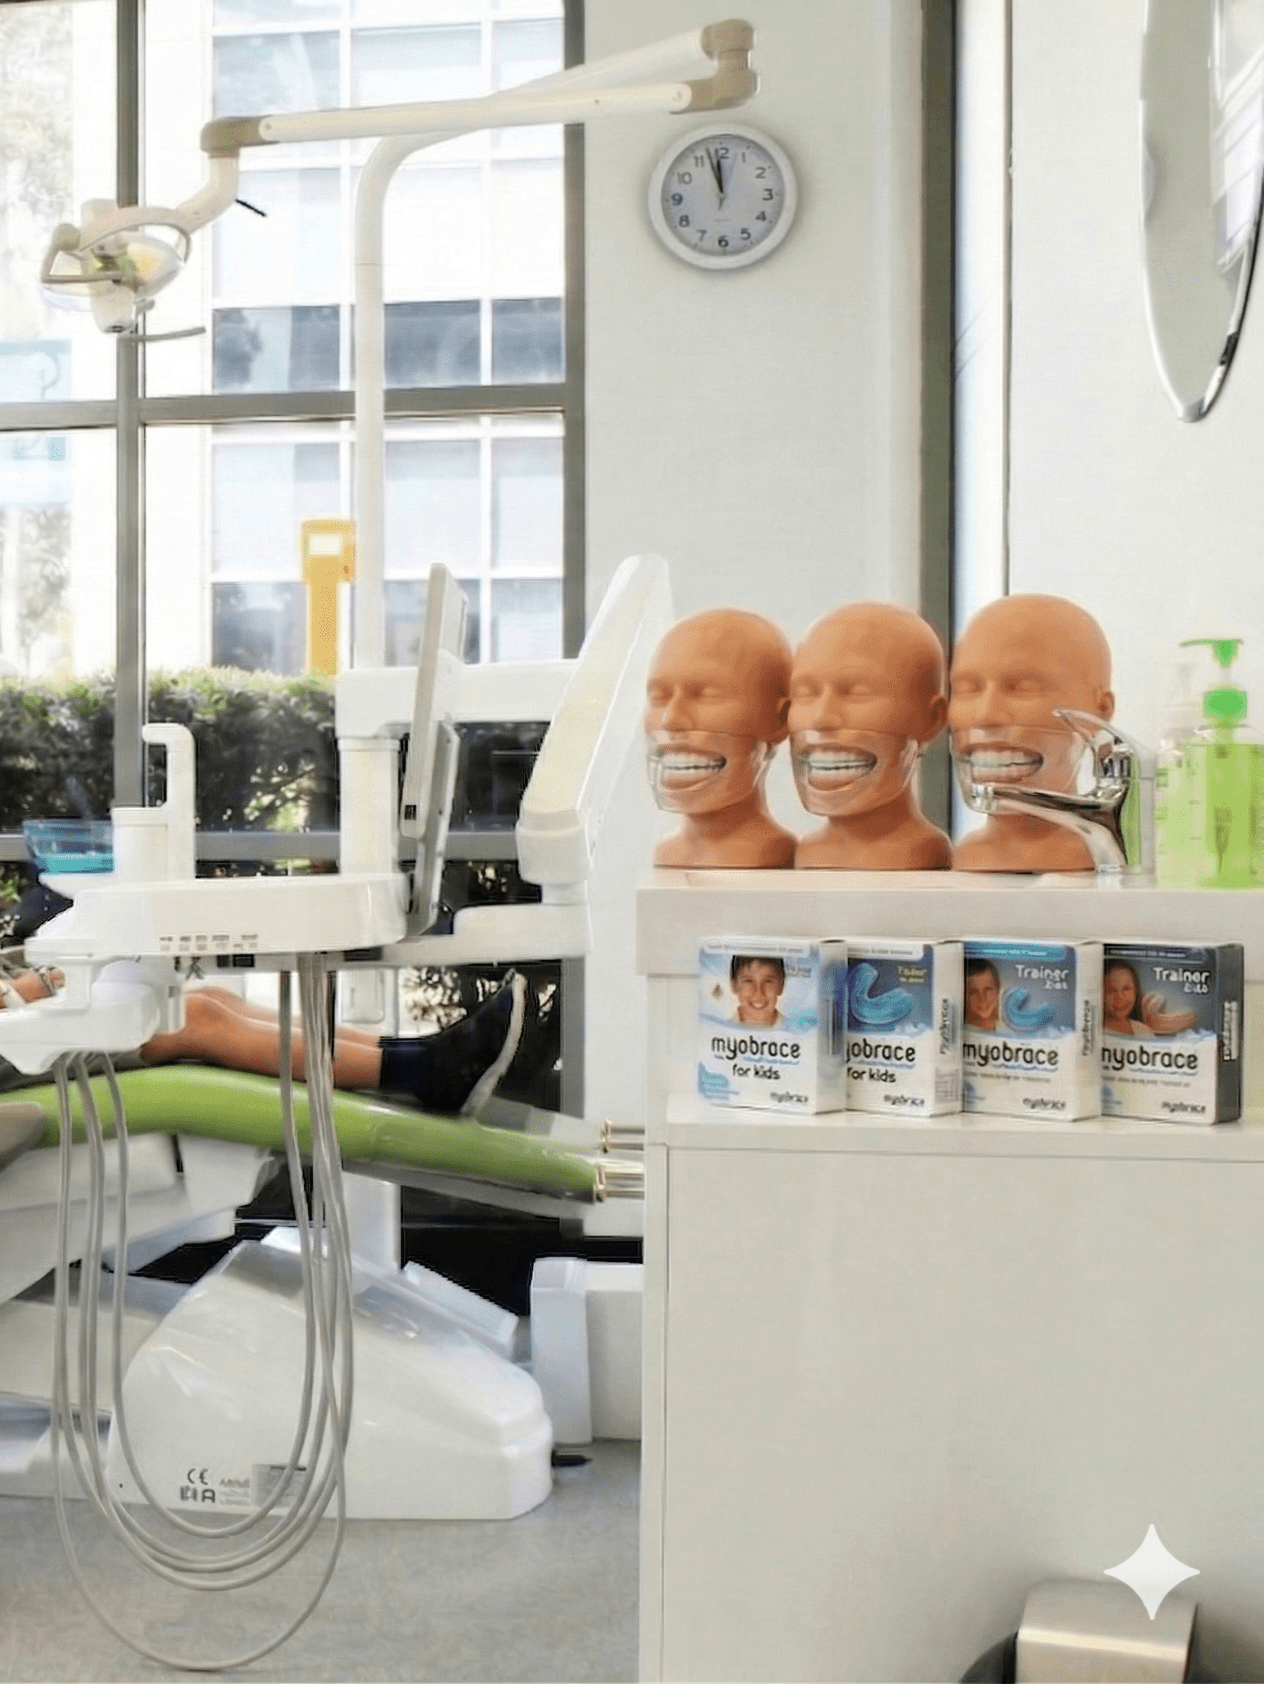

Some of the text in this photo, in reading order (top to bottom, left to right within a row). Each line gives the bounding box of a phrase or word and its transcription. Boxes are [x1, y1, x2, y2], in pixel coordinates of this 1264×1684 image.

[714, 147, 730, 160] 12
[741, 152, 747, 163] 1
[694, 155, 705, 168] 11
[677, 172, 693, 185] 10
[755, 167, 767, 179] 2
[671, 193, 684, 206] 9
[762, 188, 774, 201] 3
[679, 215, 690, 228] 8
[755, 210, 767, 222] 4
[696, 229, 707, 242] 7
[740, 228, 752, 241] 5
[718, 235, 729, 248] 6
[711, 1035, 802, 1061] myobrace
[962, 1041, 1059, 1067] myobrace
[732, 1063, 781, 1080] for kids
[869, 1067, 897, 1083] kids
